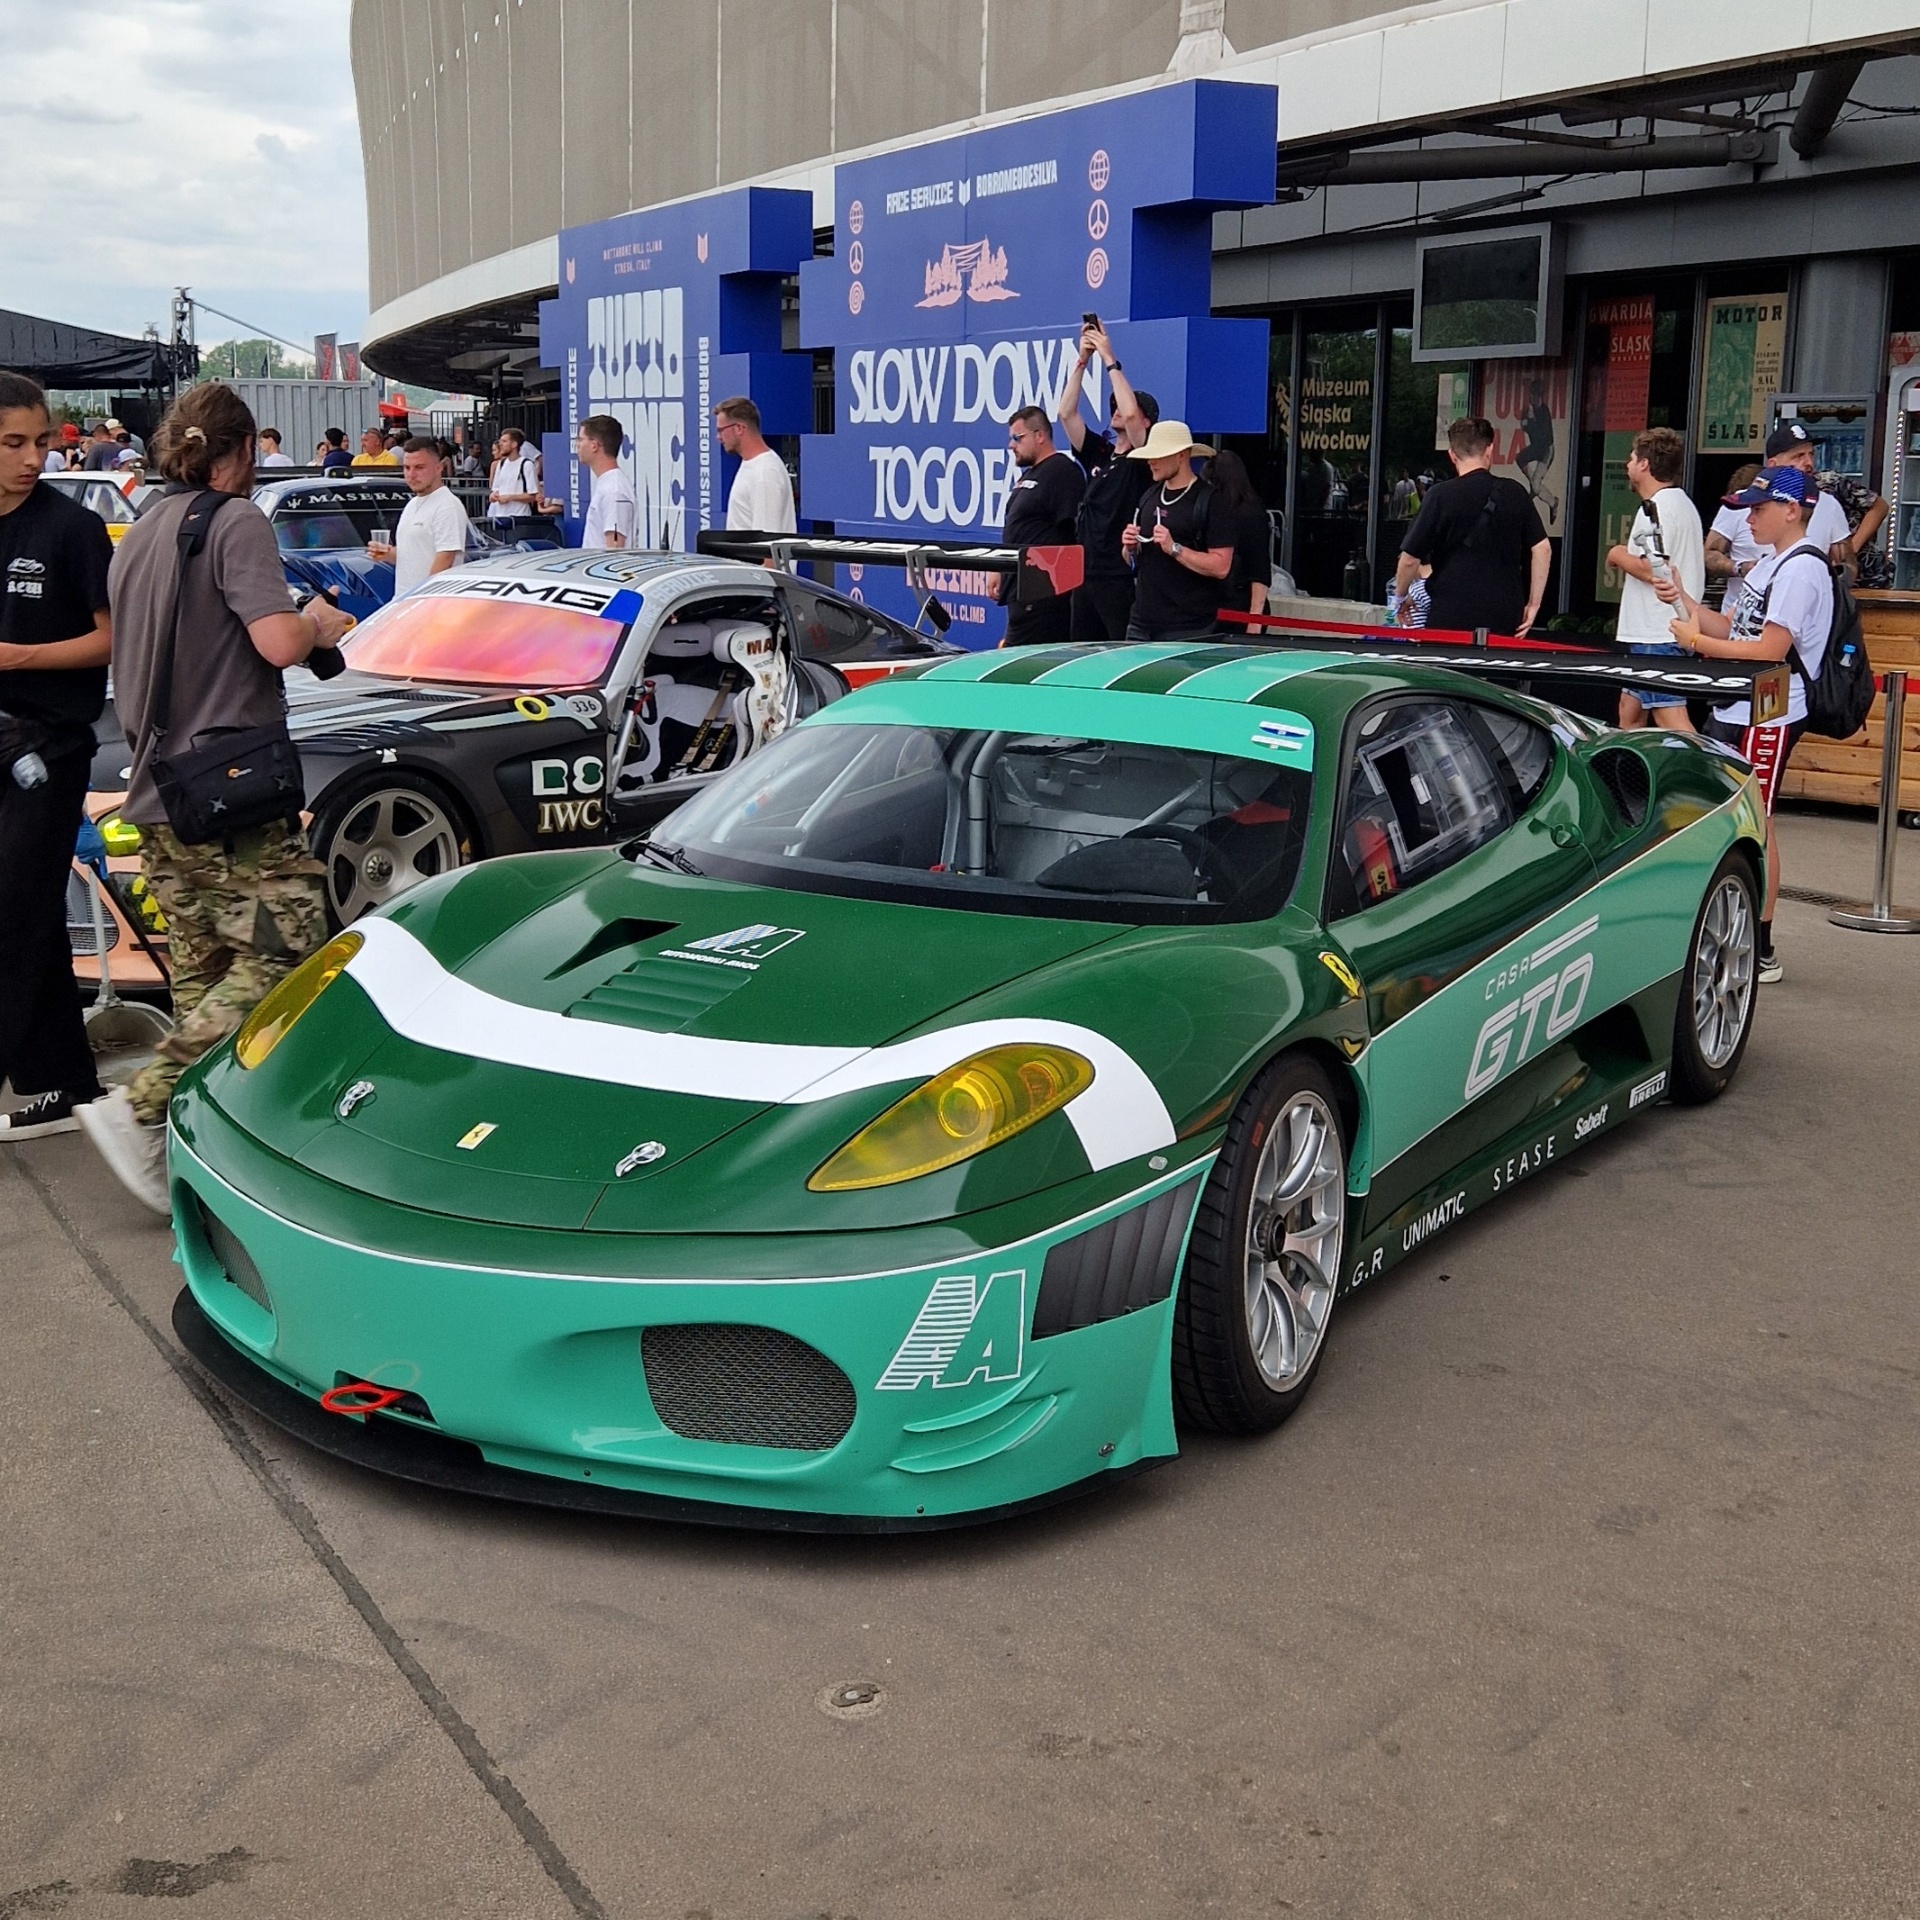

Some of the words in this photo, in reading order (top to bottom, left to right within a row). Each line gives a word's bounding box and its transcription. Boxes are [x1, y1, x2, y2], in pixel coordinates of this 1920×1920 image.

[886, 190, 909, 215] RACE
[911, 180, 954, 210] SERVICE
[976, 159, 1058, 198] BORROMEODESILVA
[1589, 302, 1653, 322] GWARDIA
[1715, 305, 1783, 324] MOTOR
[588, 287, 683, 400] TUTTO
[1611, 333, 1651, 356] ŚLĄSK
[850, 346, 951, 424] SLOW
[953, 337, 1102, 424] DOWN
[1302, 377, 1370, 397] Muzeum
[568, 347, 579, 454] SERVICE
[1300, 398, 1352, 429] Śląska
[698, 336, 711, 531] BORROMEODESILVA
[1300, 430, 1371, 450] Wrocław
[308, 491, 416, 504] MASERAT
[569, 459, 581, 519] RACE
[456, 580, 612, 612] AMG
[649, 570, 720, 602] SERVICE
[960, 604, 986, 624] CLIMB
[1553, 664, 1752, 688] AMOS
[571, 700, 597, 714] 336
[537, 799, 603, 834] IWC
[658, 949, 727, 964] AUTOMOBILI
[723, 960, 761, 970] AMOS
[1484, 956, 1531, 1001] CASA
[1464, 952, 1594, 1101] GTO
[1402, 1190, 1466, 1251] UNIMATIC
[1493, 1134, 1556, 1192] SEASE
[1574, 1103, 1609, 1140] Sabelt
[1629, 1070, 1667, 1109] PIRELLI
